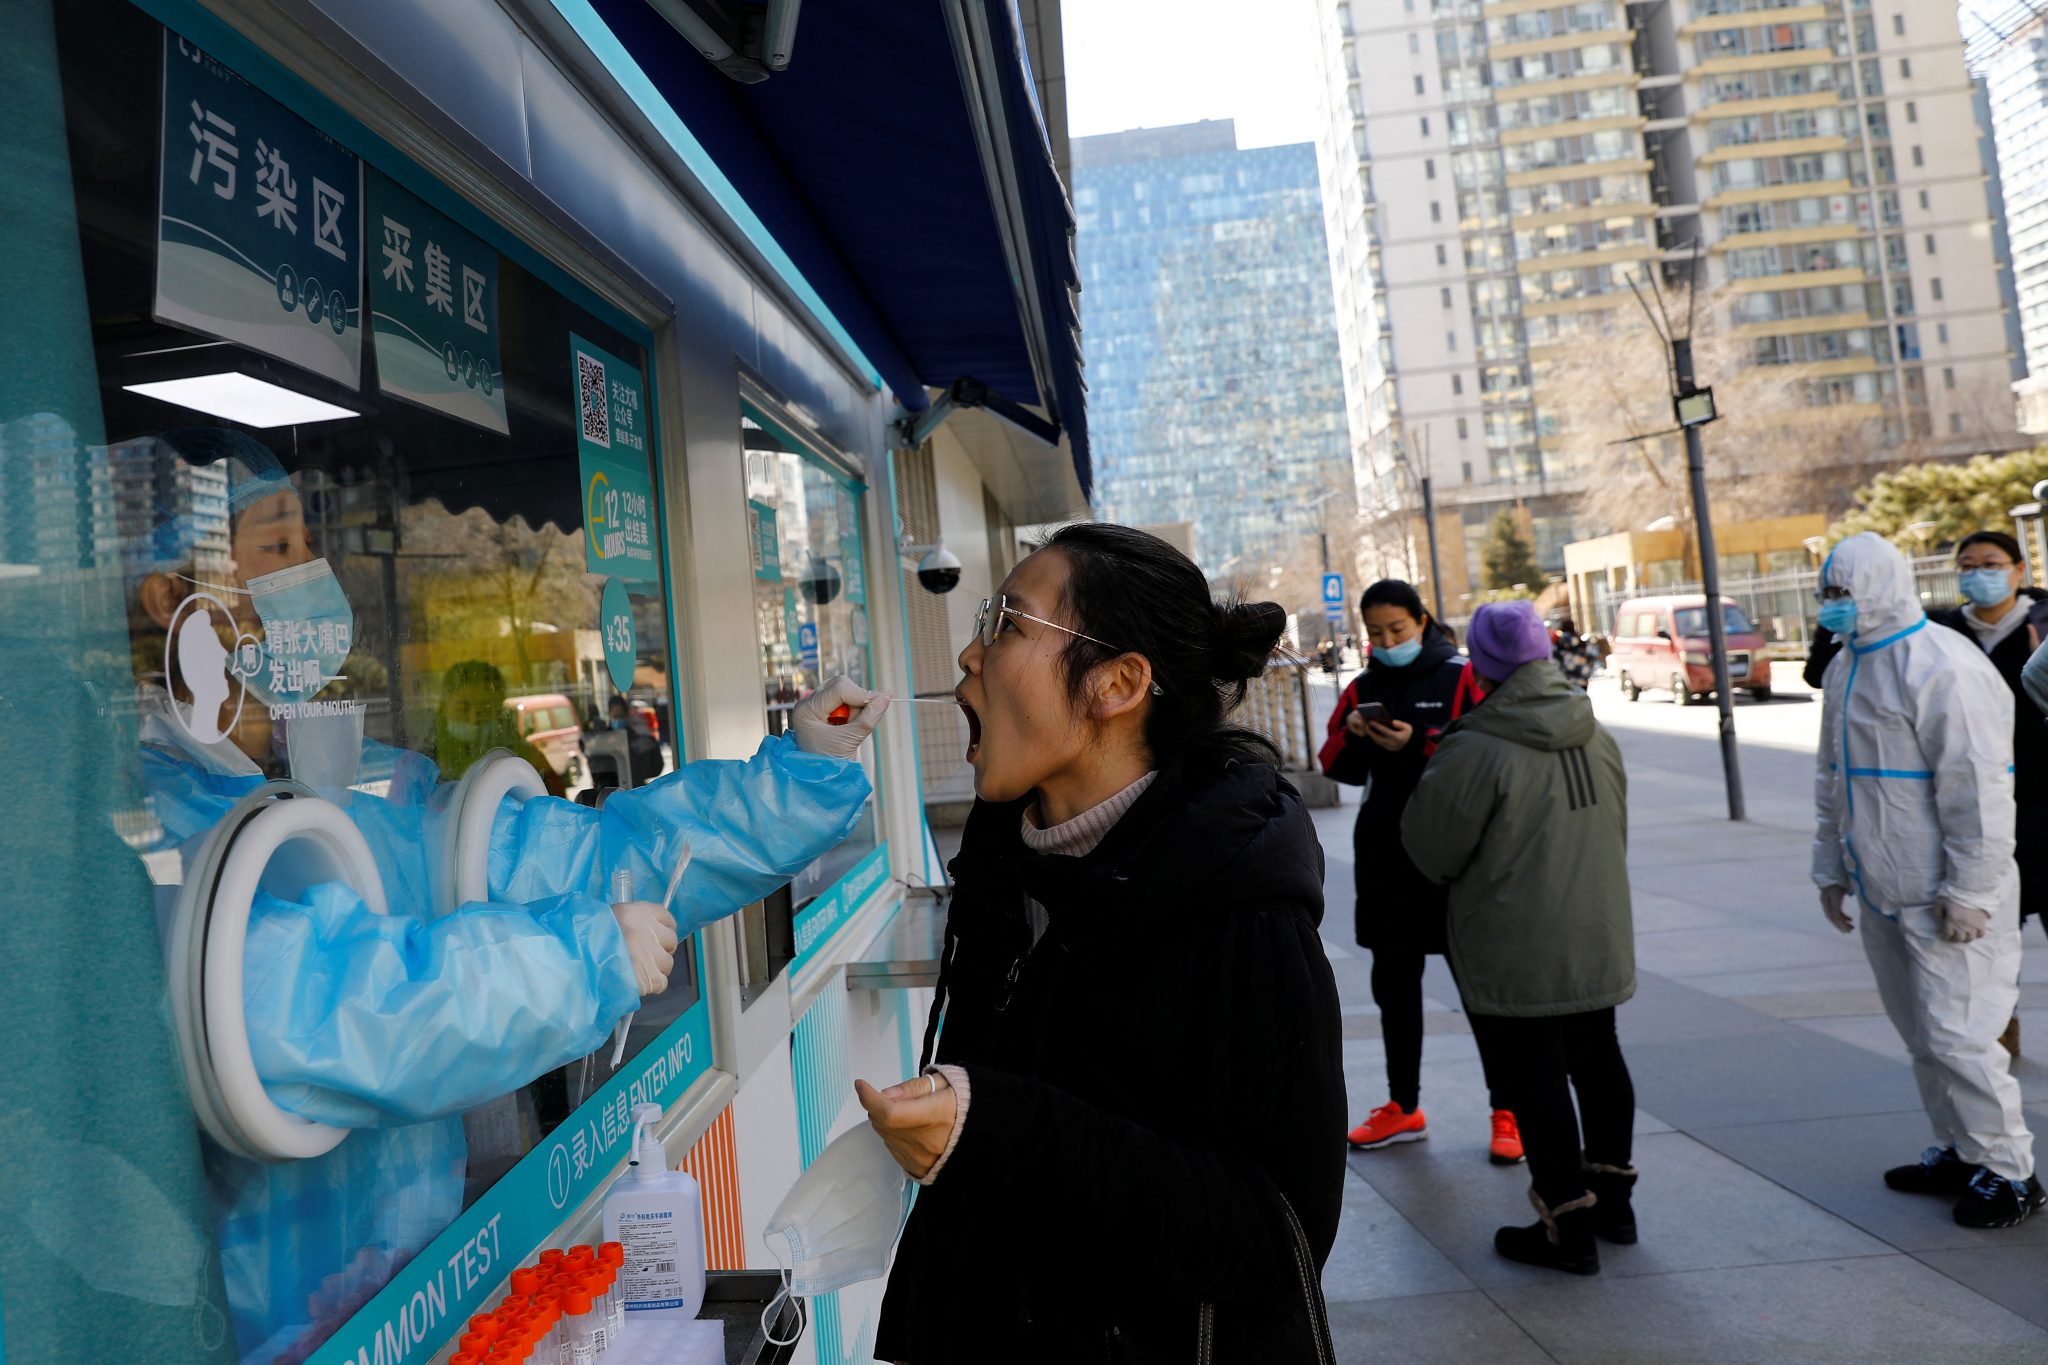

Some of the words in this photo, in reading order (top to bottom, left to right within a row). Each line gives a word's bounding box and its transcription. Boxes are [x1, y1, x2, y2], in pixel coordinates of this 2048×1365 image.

[188, 100, 347, 261] 污染区
[381, 214, 489, 334] 采集区
[605, 489, 620, 528] 12
[603, 531, 625, 559] HOURS
[265, 619, 350, 655] 请张大嘴巴
[270, 703, 296, 720] OPEN
[297, 702, 324, 718] YOUR
[324, 699, 356, 716] MOUTH
[629, 1056, 668, 1111] ENTER
[668, 1032, 692, 1081] INFO
[343, 1269, 447, 1365] MMON
[448, 1212, 501, 1302] TEST
